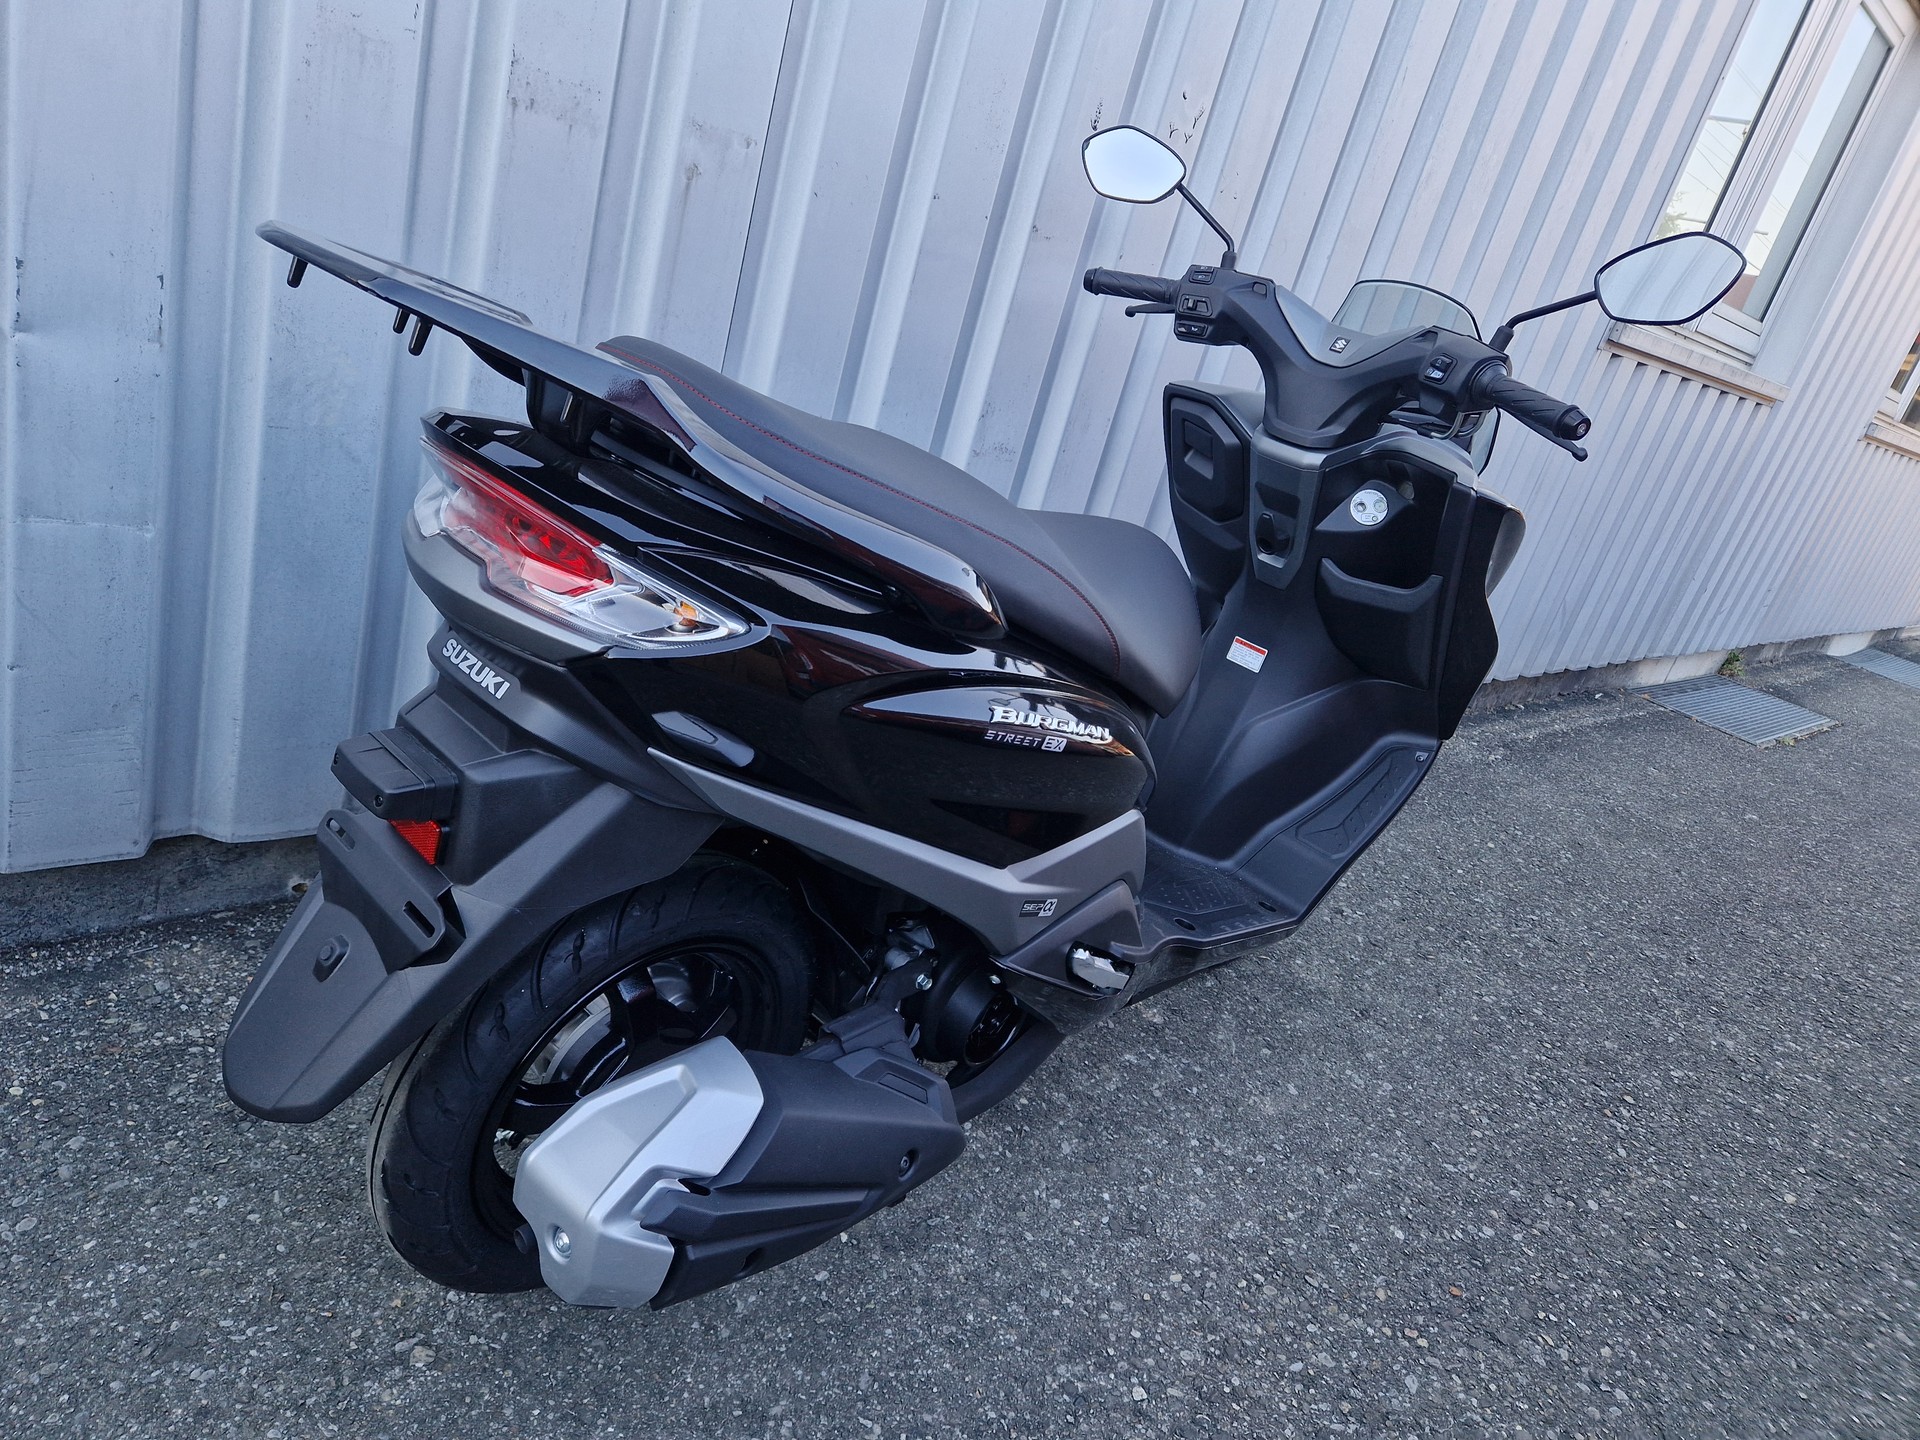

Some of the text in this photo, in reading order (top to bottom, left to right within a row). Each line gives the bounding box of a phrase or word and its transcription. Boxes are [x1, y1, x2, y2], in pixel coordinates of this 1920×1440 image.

[442, 638, 511, 700] SUZUKI
[984, 730, 1066, 751] STREET EX
[989, 705, 1112, 743] BURGMAN
